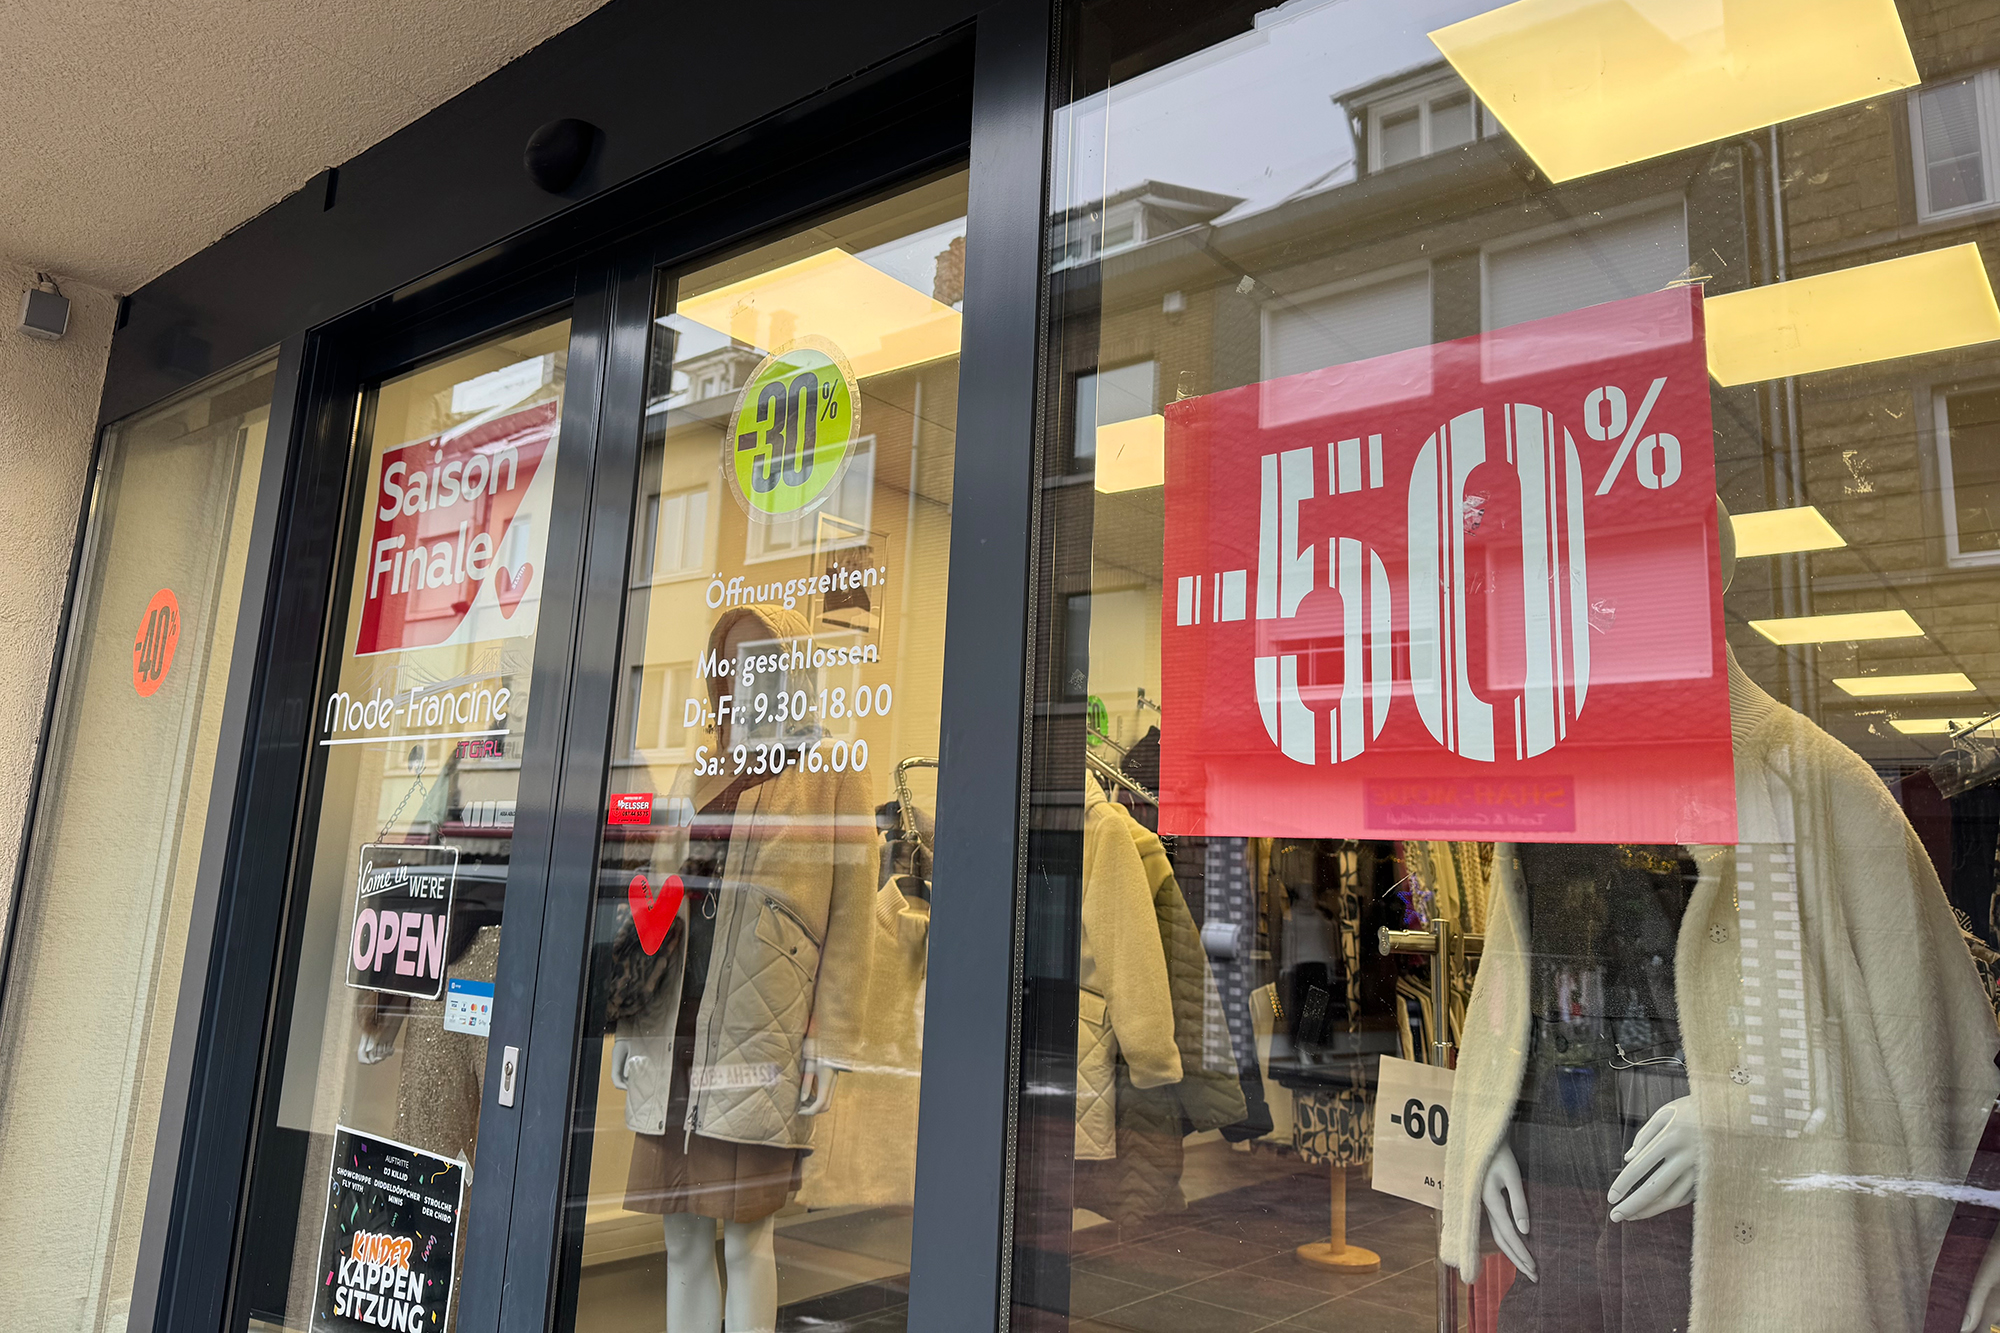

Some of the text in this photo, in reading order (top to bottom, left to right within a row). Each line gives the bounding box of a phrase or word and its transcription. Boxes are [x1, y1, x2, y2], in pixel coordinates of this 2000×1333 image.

[738, 372, 838, 493] -30%
[379, 445, 518, 522] Saison
[370, 520, 493, 600] Finale
[1177, 377, 1682, 766] -50%
[705, 562, 886, 610] Öffnungszeiten:
[135, 605, 178, 683] -40%
[696, 638, 877, 687] Mo: geschlossen
[324, 684, 511, 733] Mode-Francine
[683, 683, 892, 728] Di-Fr: 9.30-18.00
[694, 739, 868, 776] Sa: 9.30-16.00
[361, 858, 446, 899] Come in WE'RE
[353, 908, 446, 979] OPEN
[1391, 1098, 1449, 1146] -60
[336, 1167, 372, 1185] SHOWGRUPPE
[341, 1179, 351, 1188] FLY
[383, 1167, 391, 1176] DJ
[385, 1154, 410, 1169] AUFTRITTE
[1424, 1176, 1435, 1187] Ab
[422, 1206, 452, 1224] DER CHIRO
[424, 1196, 453, 1213] STROLCHE
[351, 1229, 414, 1271] KINDER
[337, 1256, 425, 1304] KAPPEN
[334, 1286, 426, 1333] SITZUNG
